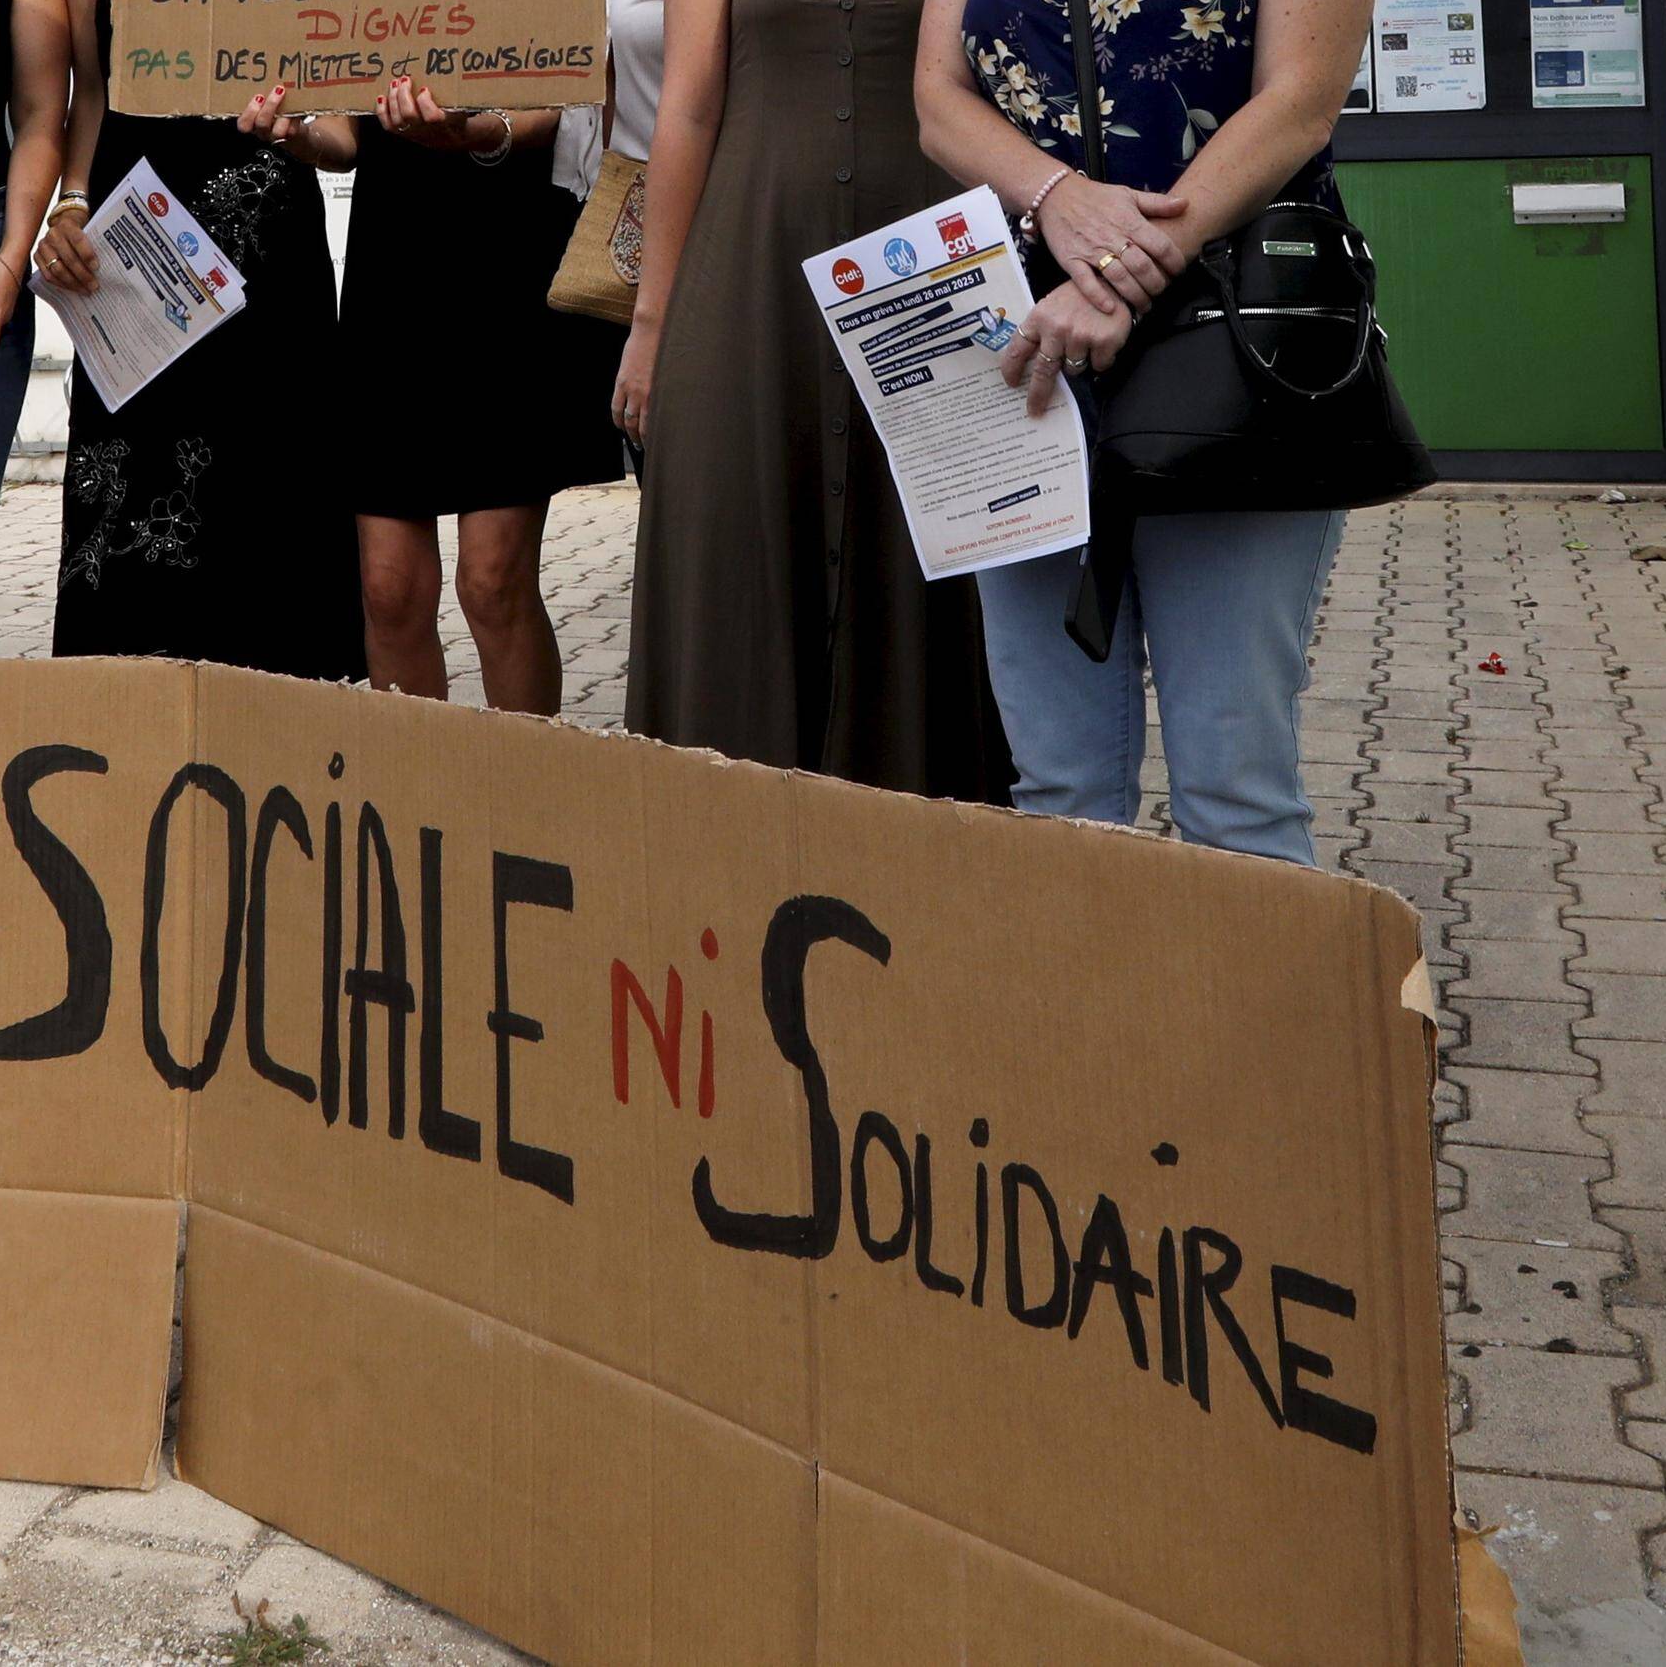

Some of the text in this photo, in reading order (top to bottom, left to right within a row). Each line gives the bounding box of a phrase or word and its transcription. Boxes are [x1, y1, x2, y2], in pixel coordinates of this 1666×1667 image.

[127, 48, 194, 80] PAS
[215, 49, 267, 82] DES
[391, 51, 420, 78] et
[425, 49, 459, 74] DES
[943, 232, 976, 259] cgt
[838, 315, 860, 331] Tous
[859, 312, 872, 324] en
[871, 303, 894, 320] grève
[892, 299, 903, 311] le
[901, 292, 923, 308] lundi
[922, 288, 935, 301] 26
[933, 282, 951, 297] mai
[950, 274, 975, 290] 2025
[881, 377, 904, 393] C'est
[905, 373, 924, 387] NON
